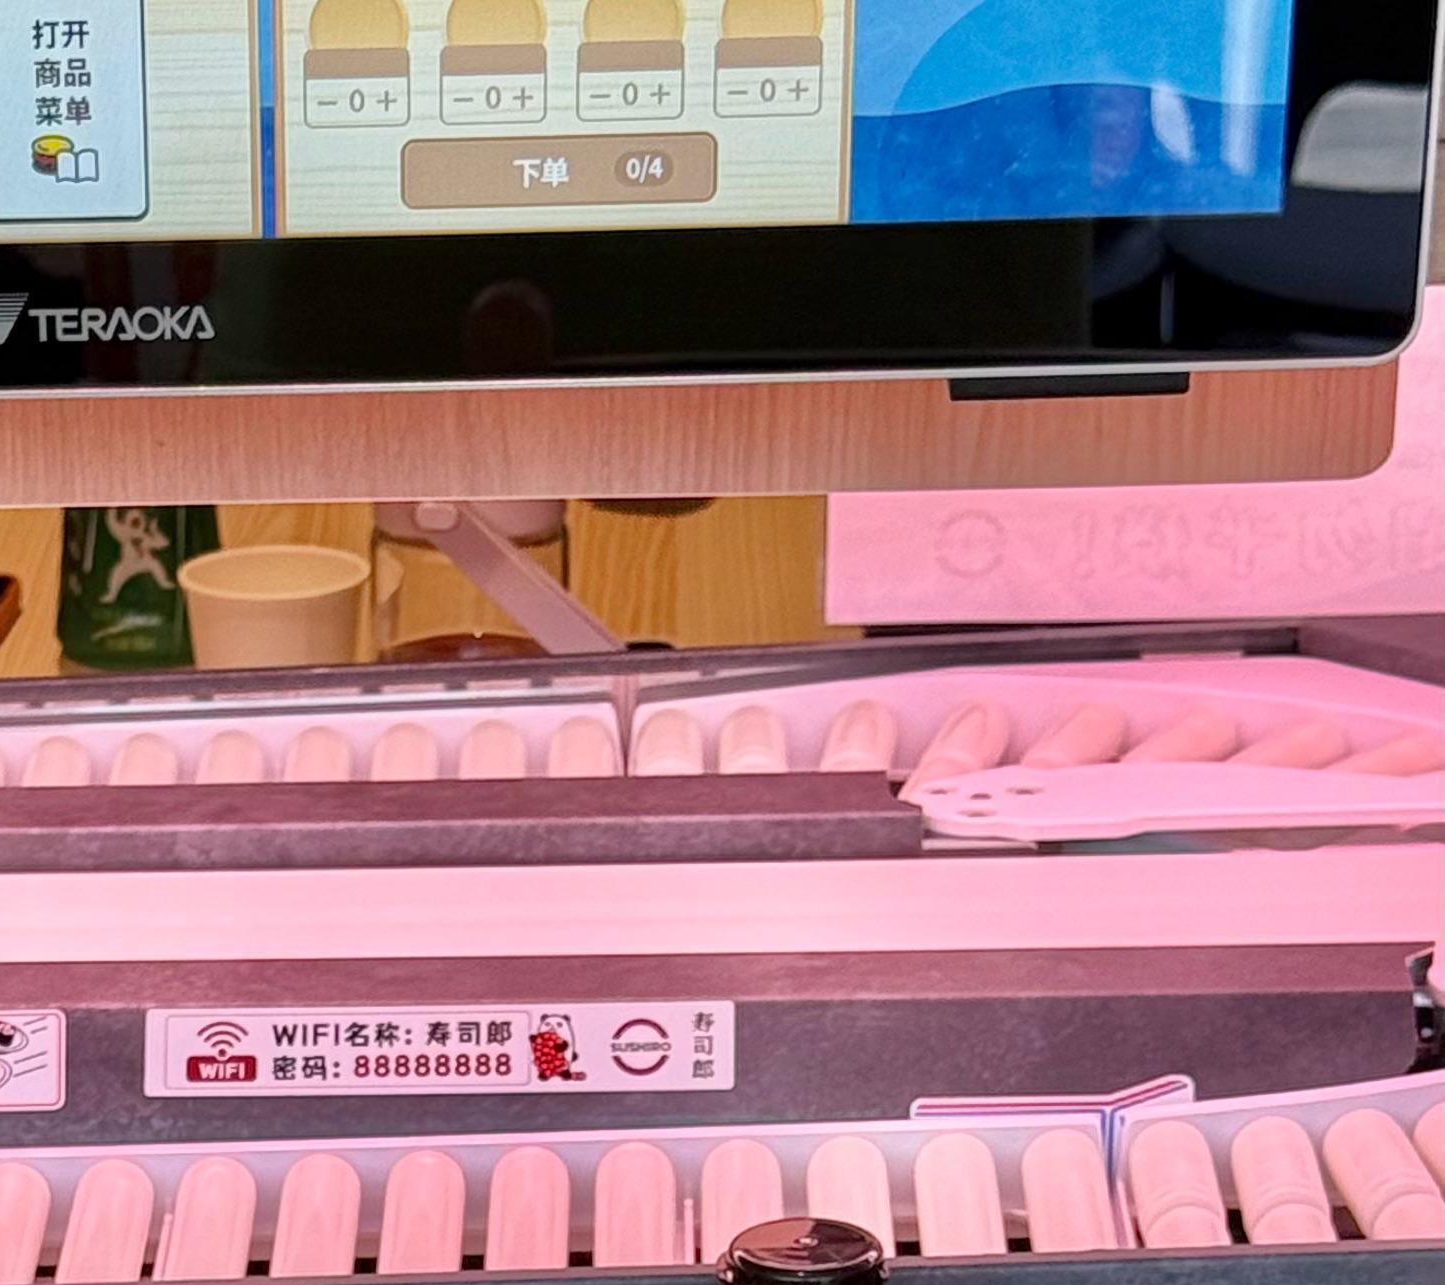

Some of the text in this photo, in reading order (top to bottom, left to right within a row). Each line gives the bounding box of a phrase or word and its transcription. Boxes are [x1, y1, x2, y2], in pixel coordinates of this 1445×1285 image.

[32, 20, 91, 50] 打开
[33, 58, 92, 88] 商品
[34, 96, 92, 126] 菜单
[511, 158, 570, 188] 下单
[624, 155, 664, 185] 0/4
[30, 306, 215, 344] TERAOKA
[198, 1061, 246, 1080] WIFI
